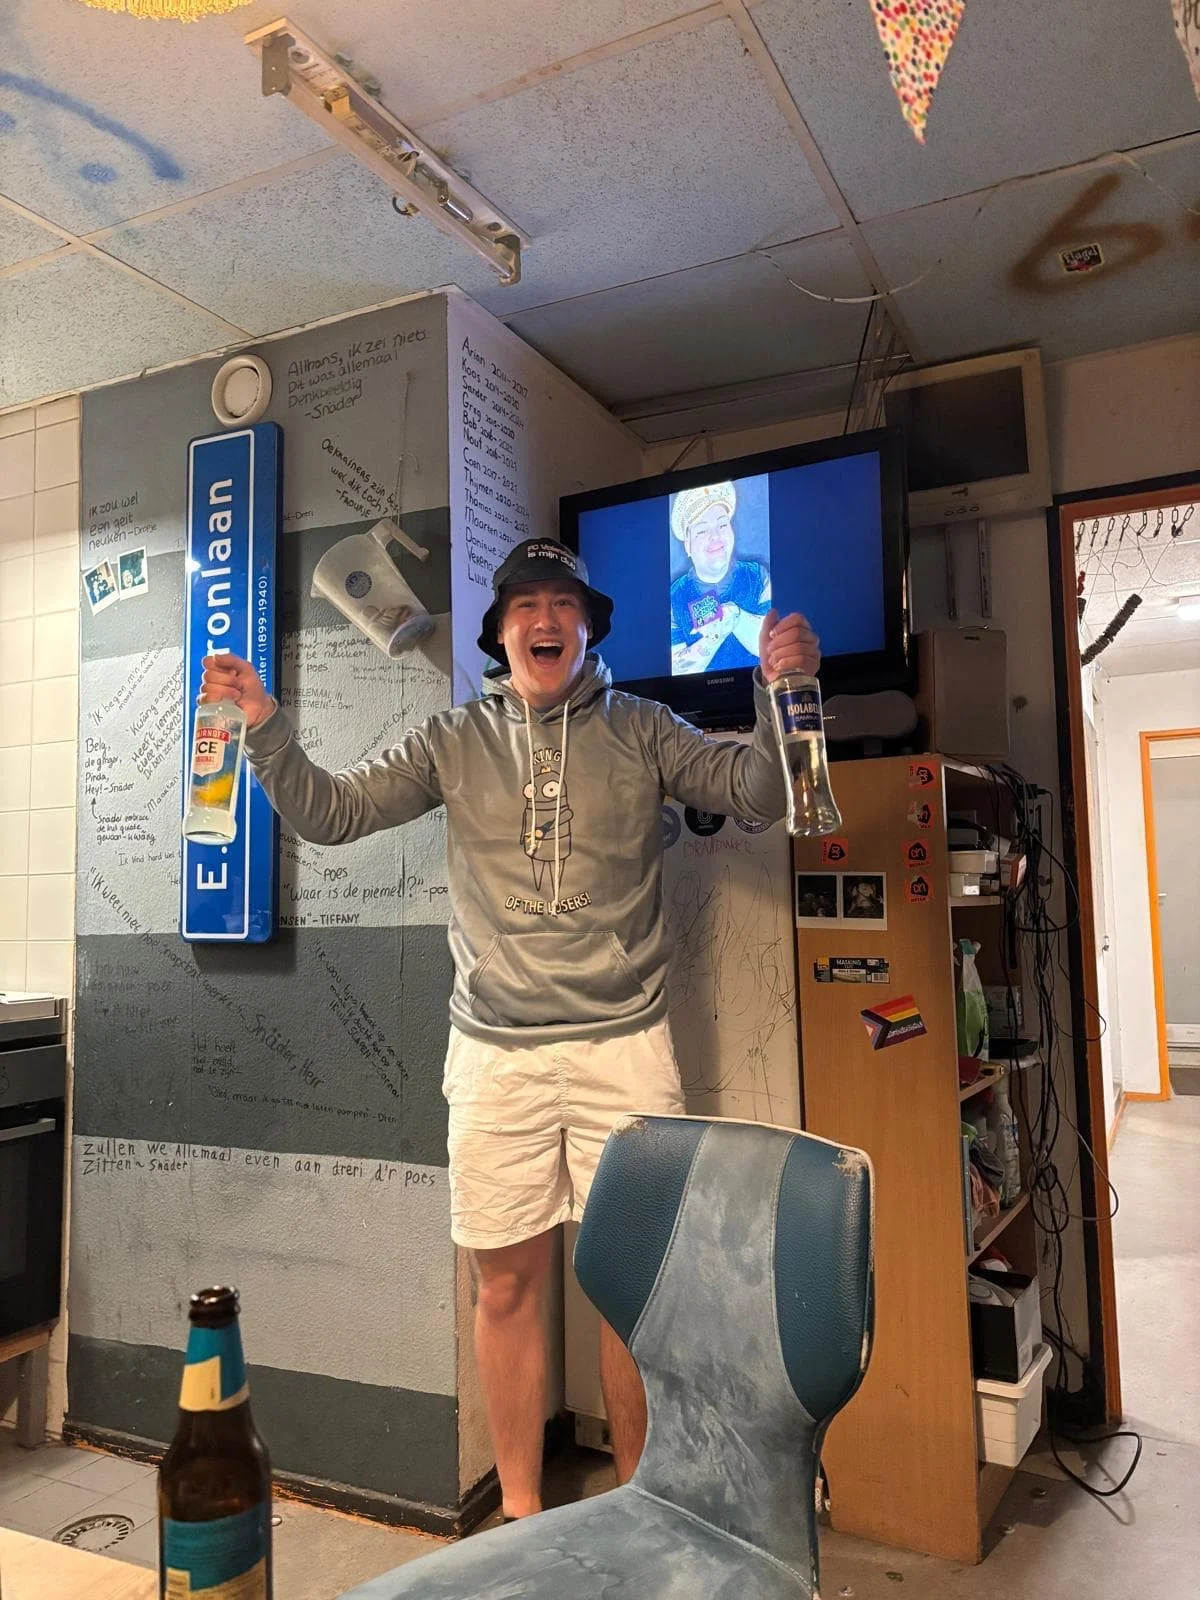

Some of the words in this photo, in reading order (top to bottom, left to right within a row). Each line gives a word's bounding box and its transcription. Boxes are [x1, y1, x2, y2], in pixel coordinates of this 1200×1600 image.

[257, 575, 268, 653] (1899-1940)
[505, 895, 521, 911] OF
[523, 899, 545, 914] THE
[294, 1160, 321, 1174] aan
[405, 1170, 436, 1187] poes
